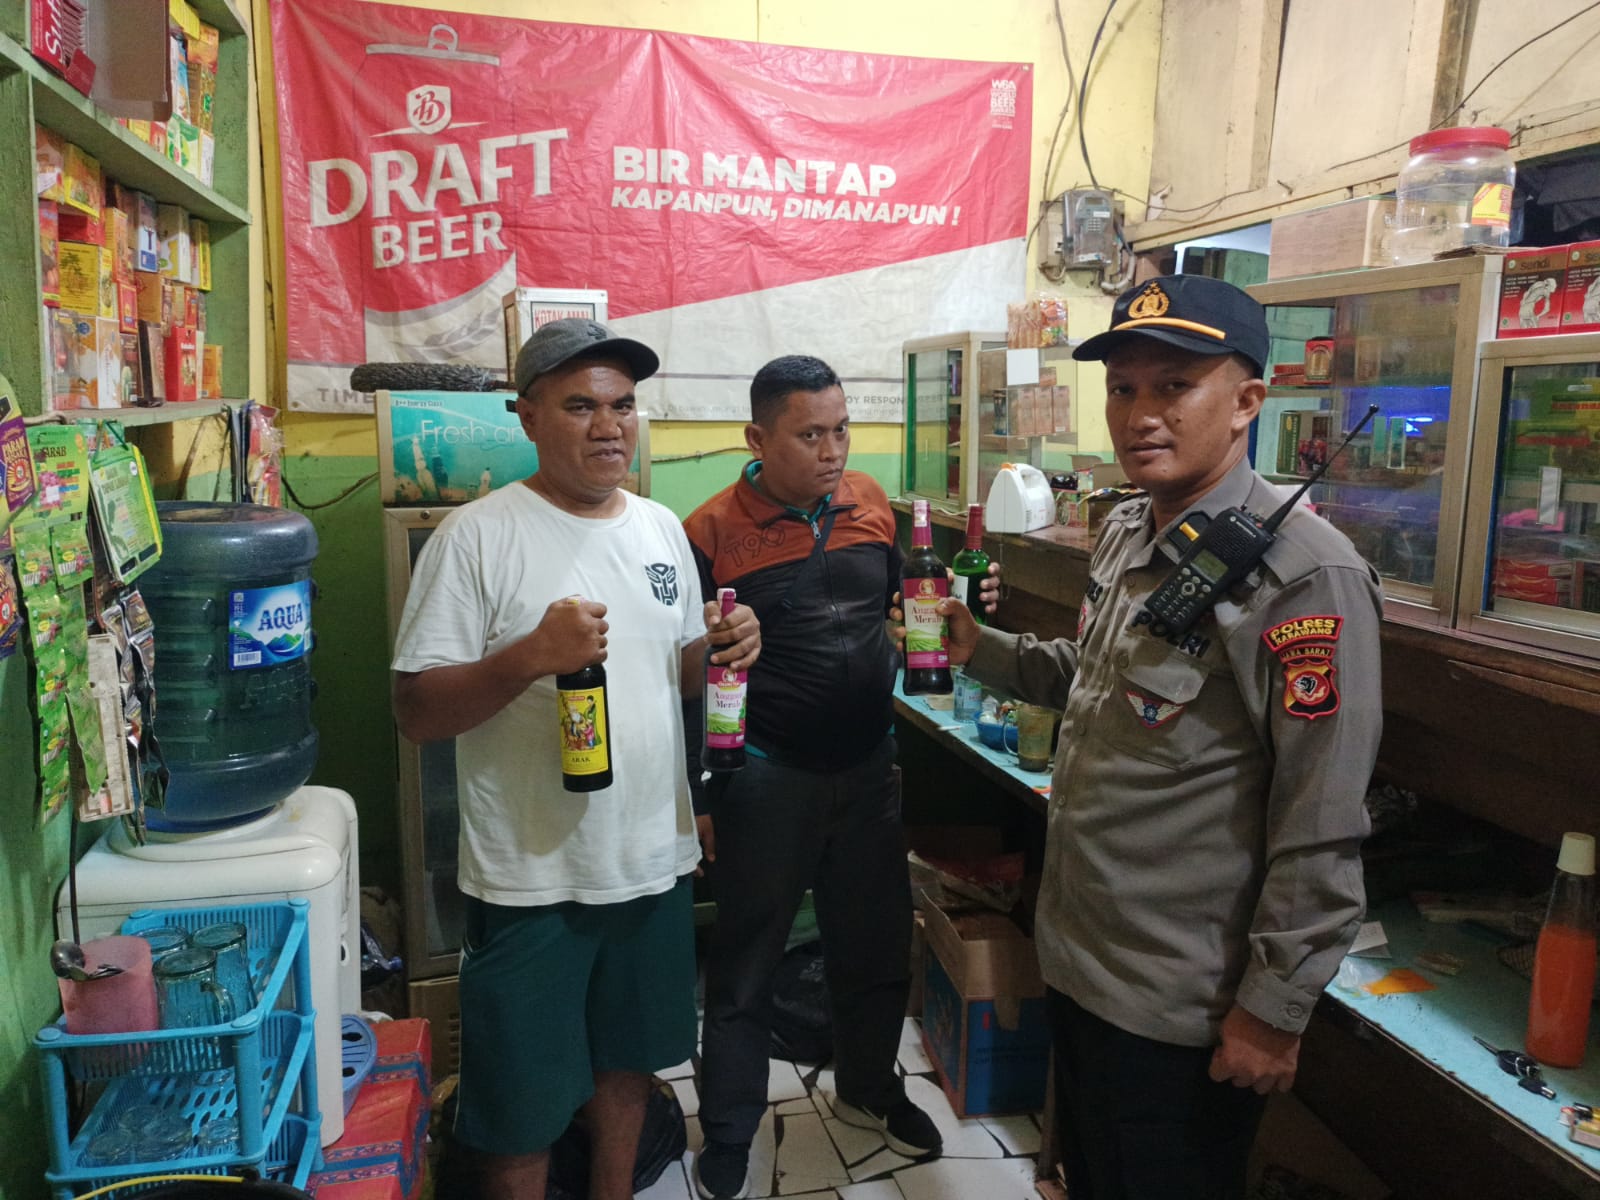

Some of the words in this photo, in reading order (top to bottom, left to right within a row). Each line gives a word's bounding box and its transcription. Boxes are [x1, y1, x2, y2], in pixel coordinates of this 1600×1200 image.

[307, 128, 569, 228] DRAFT
[613, 146, 690, 186] BIR
[702, 152, 896, 197] MANTAP
[611, 187, 778, 221] KAPANPUN,
[782, 198, 946, 226] DIMANAPUN
[371, 210, 508, 269] BEER
[317, 387, 375, 404] TIME
[420, 419, 486, 445] Fresh
[257, 602, 304, 632] AQUA
[913, 614, 943, 624] Merah
[1269, 618, 1335, 641] POLRES
[715, 699, 741, 709] Merah
